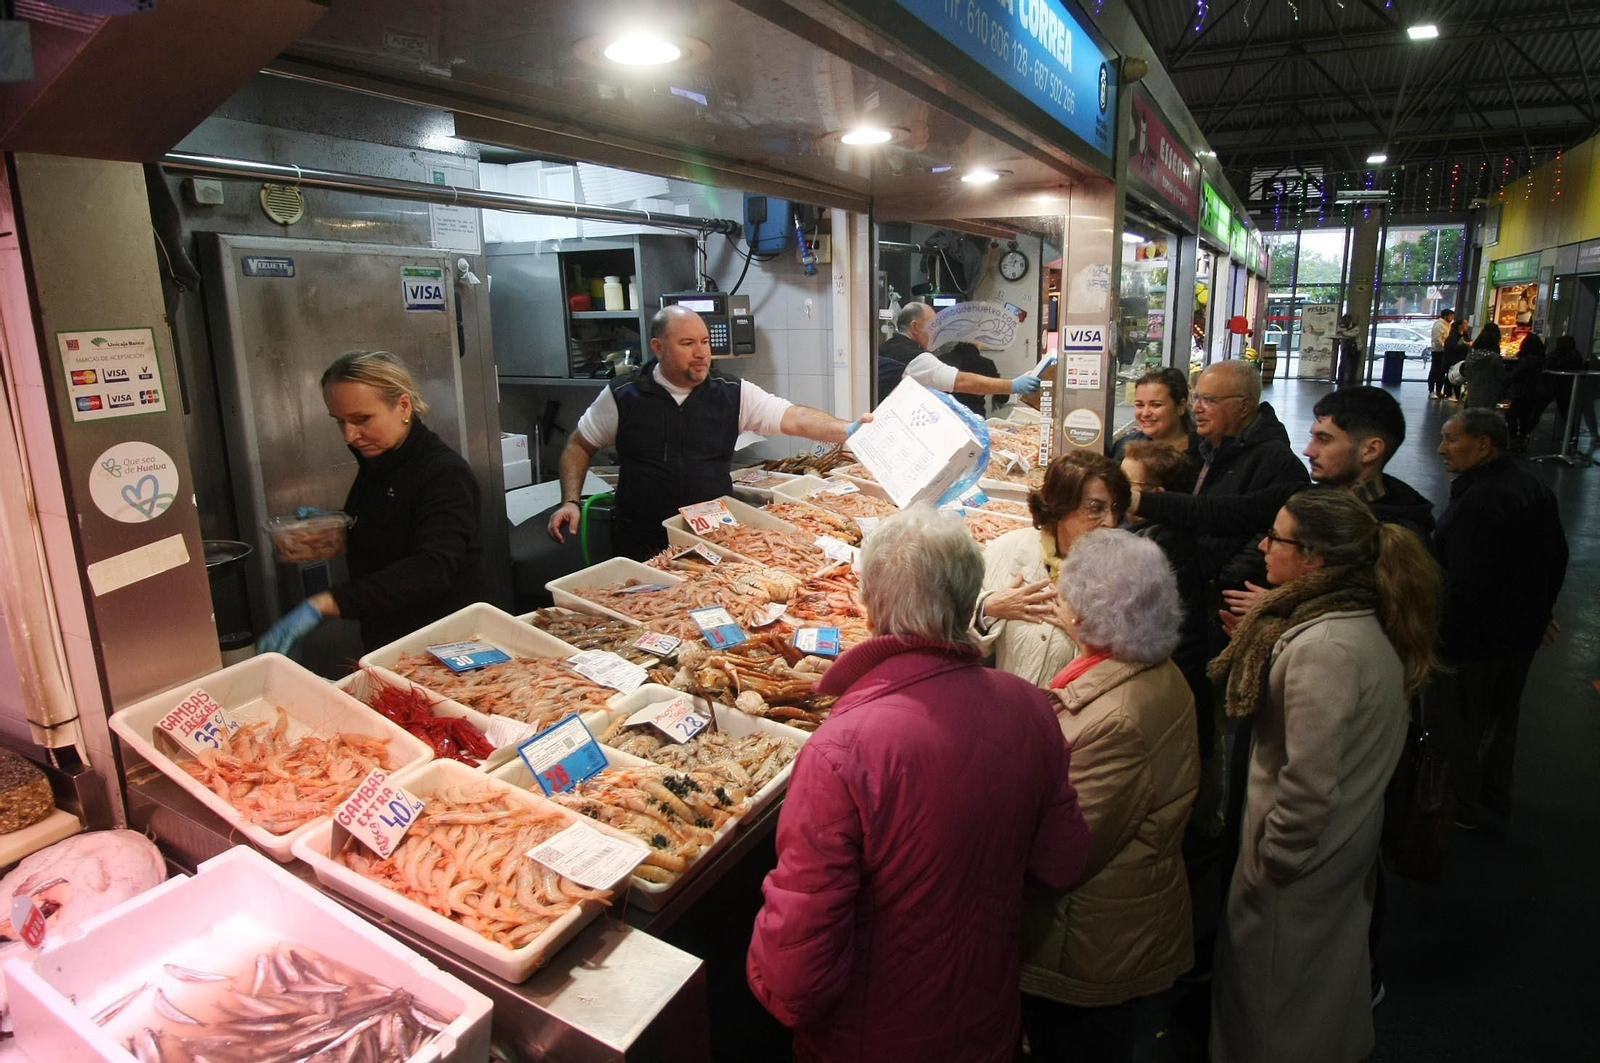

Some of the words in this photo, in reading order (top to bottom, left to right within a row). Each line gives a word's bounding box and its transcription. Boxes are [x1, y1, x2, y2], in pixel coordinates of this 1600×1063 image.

[1018, 0, 1073, 74] CORREA
[967, 0, 989, 45] 610
[990, 20, 1010, 62] 806
[1012, 40, 1028, 77] 128
[1034, 59, 1049, 92] 687
[1050, 72, 1063, 106] 502
[409, 285, 442, 300] VISA
[1069, 331, 1102, 342] VISA
[107, 369, 128, 377] VISA
[112, 395, 132, 403] VISA
[123, 458, 140, 467] Que
[125, 466, 135, 474] de
[137, 463, 167, 473] Huelva
[690, 517, 710, 533] 20
[451, 655, 475, 667] 30
[160, 690, 210, 732] GAMBAS
[180, 701, 219, 736] FRESCAS
[675, 716, 704, 737] 28
[338, 770, 385, 827] GAMBAS
[357, 787, 394, 827] EXTRA
[379, 800, 412, 829] 40
